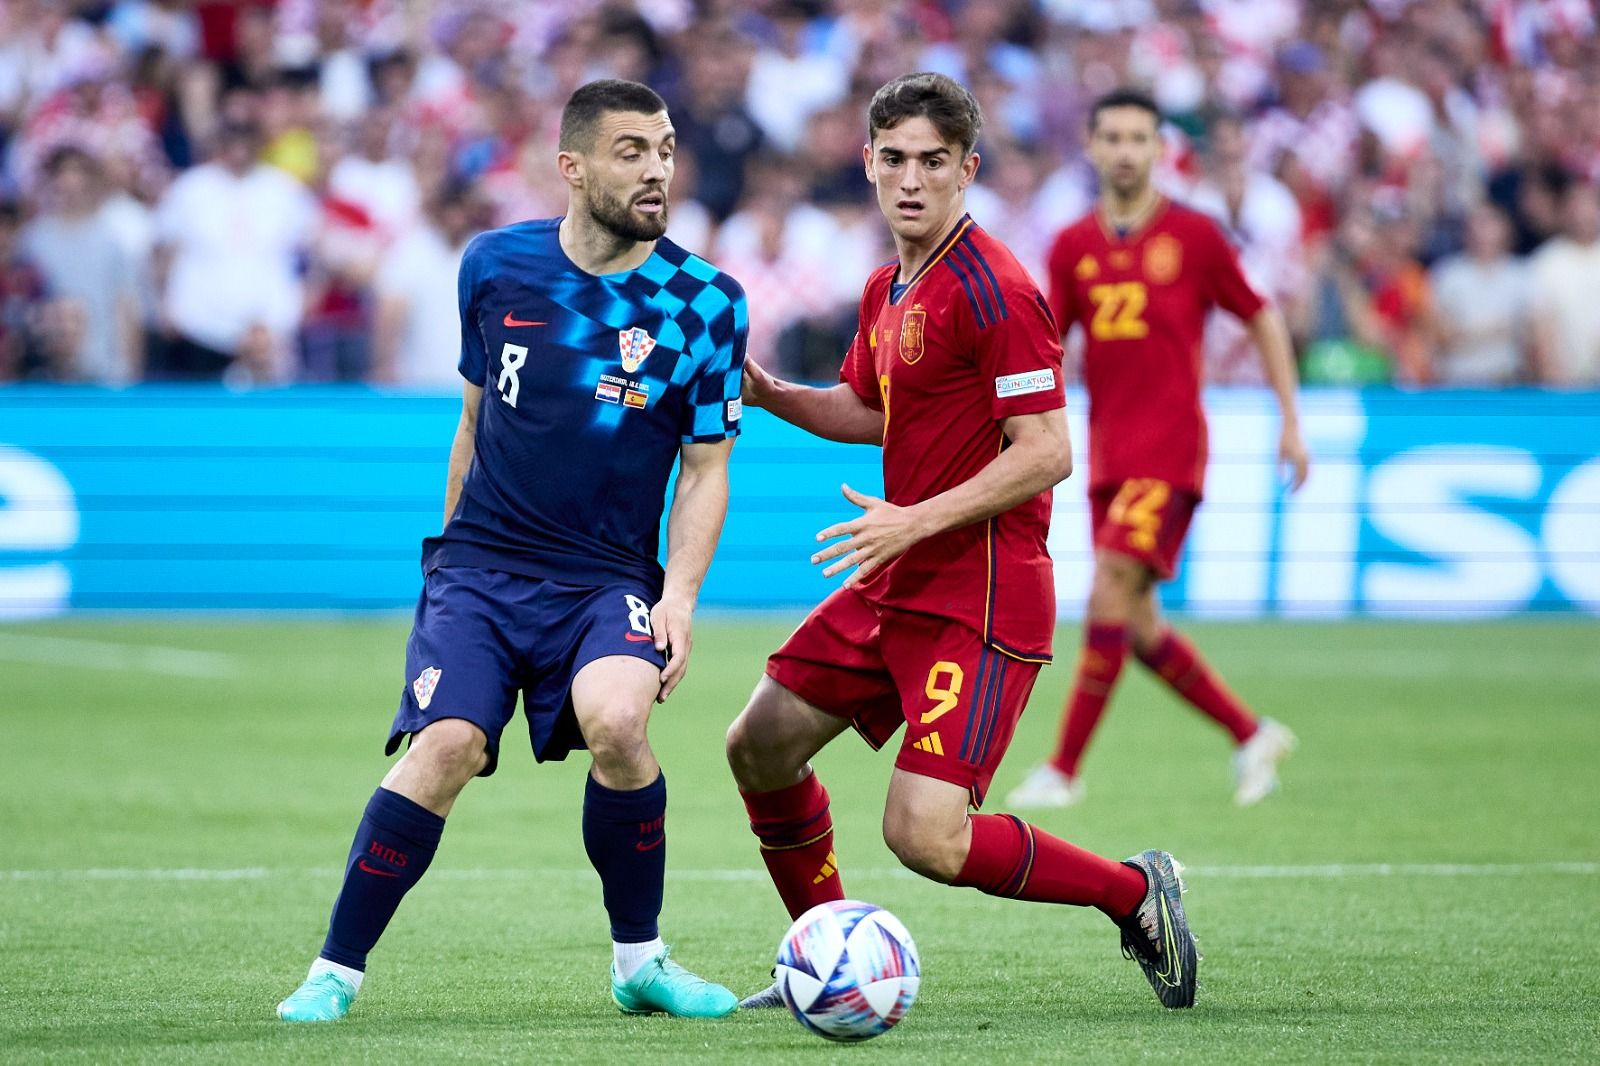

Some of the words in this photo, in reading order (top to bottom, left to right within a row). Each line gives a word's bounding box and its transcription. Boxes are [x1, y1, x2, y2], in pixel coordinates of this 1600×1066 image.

[1088, 281, 1149, 341] 22
[497, 342, 529, 409] 8
[997, 375, 1053, 389] FOUNDATION
[623, 594, 652, 637] 8
[920, 660, 964, 724] 9
[369, 839, 408, 868] HNS
